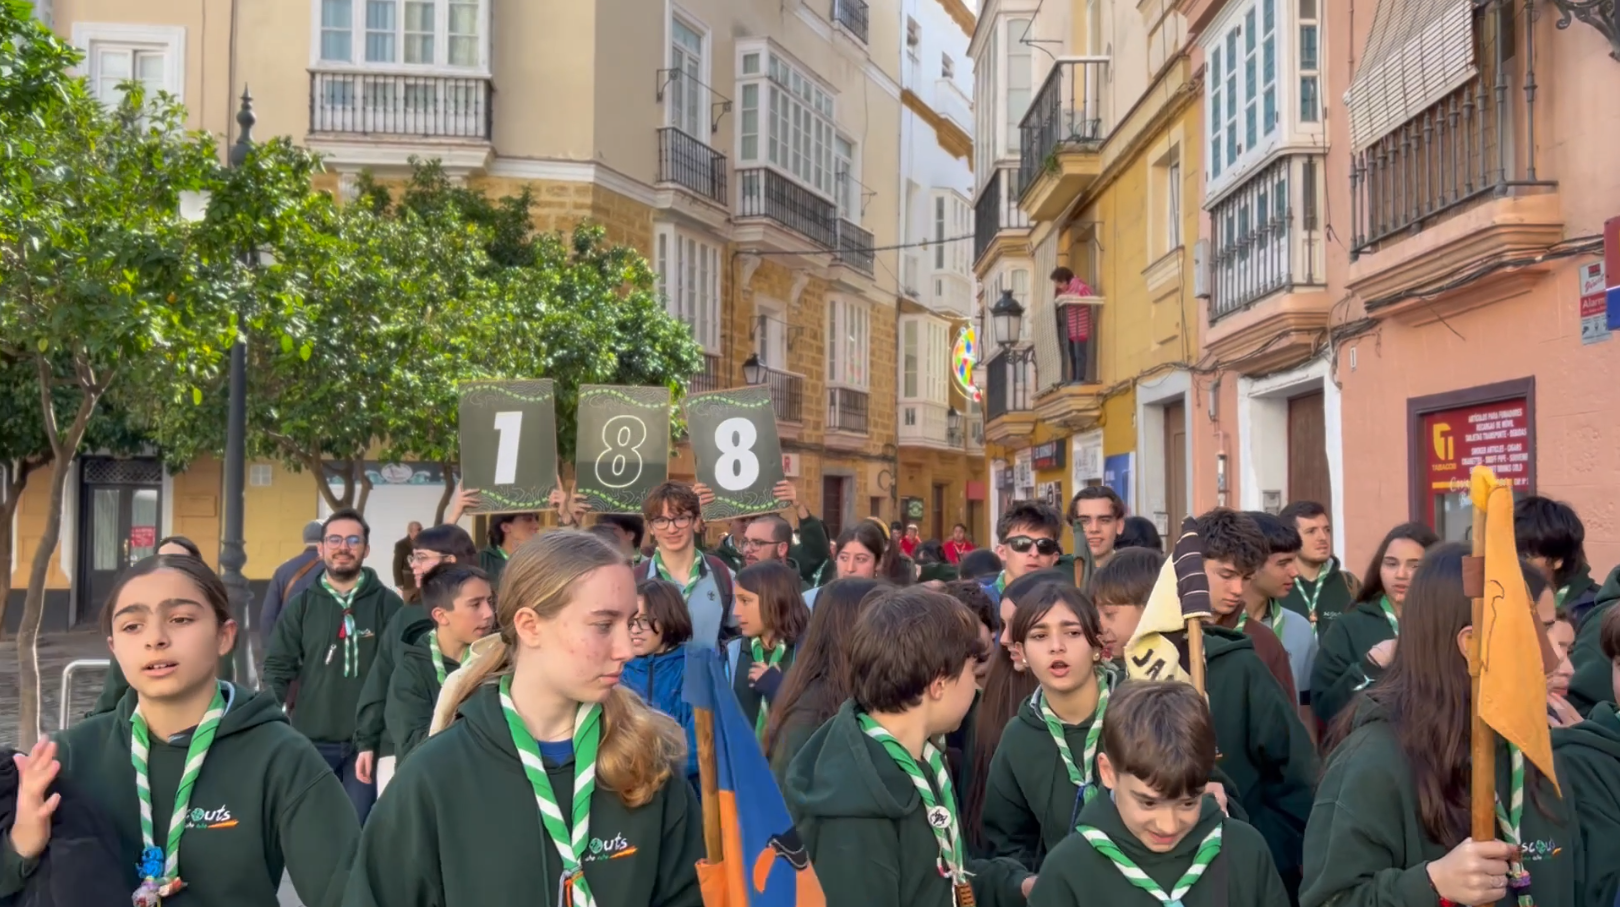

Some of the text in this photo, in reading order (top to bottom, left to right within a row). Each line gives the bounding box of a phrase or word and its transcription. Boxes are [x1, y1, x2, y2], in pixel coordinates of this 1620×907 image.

[494, 411, 522, 485] 1
[595, 415, 646, 488] 8
[714, 417, 760, 491] 8
[1132, 648, 1174, 681] JA
